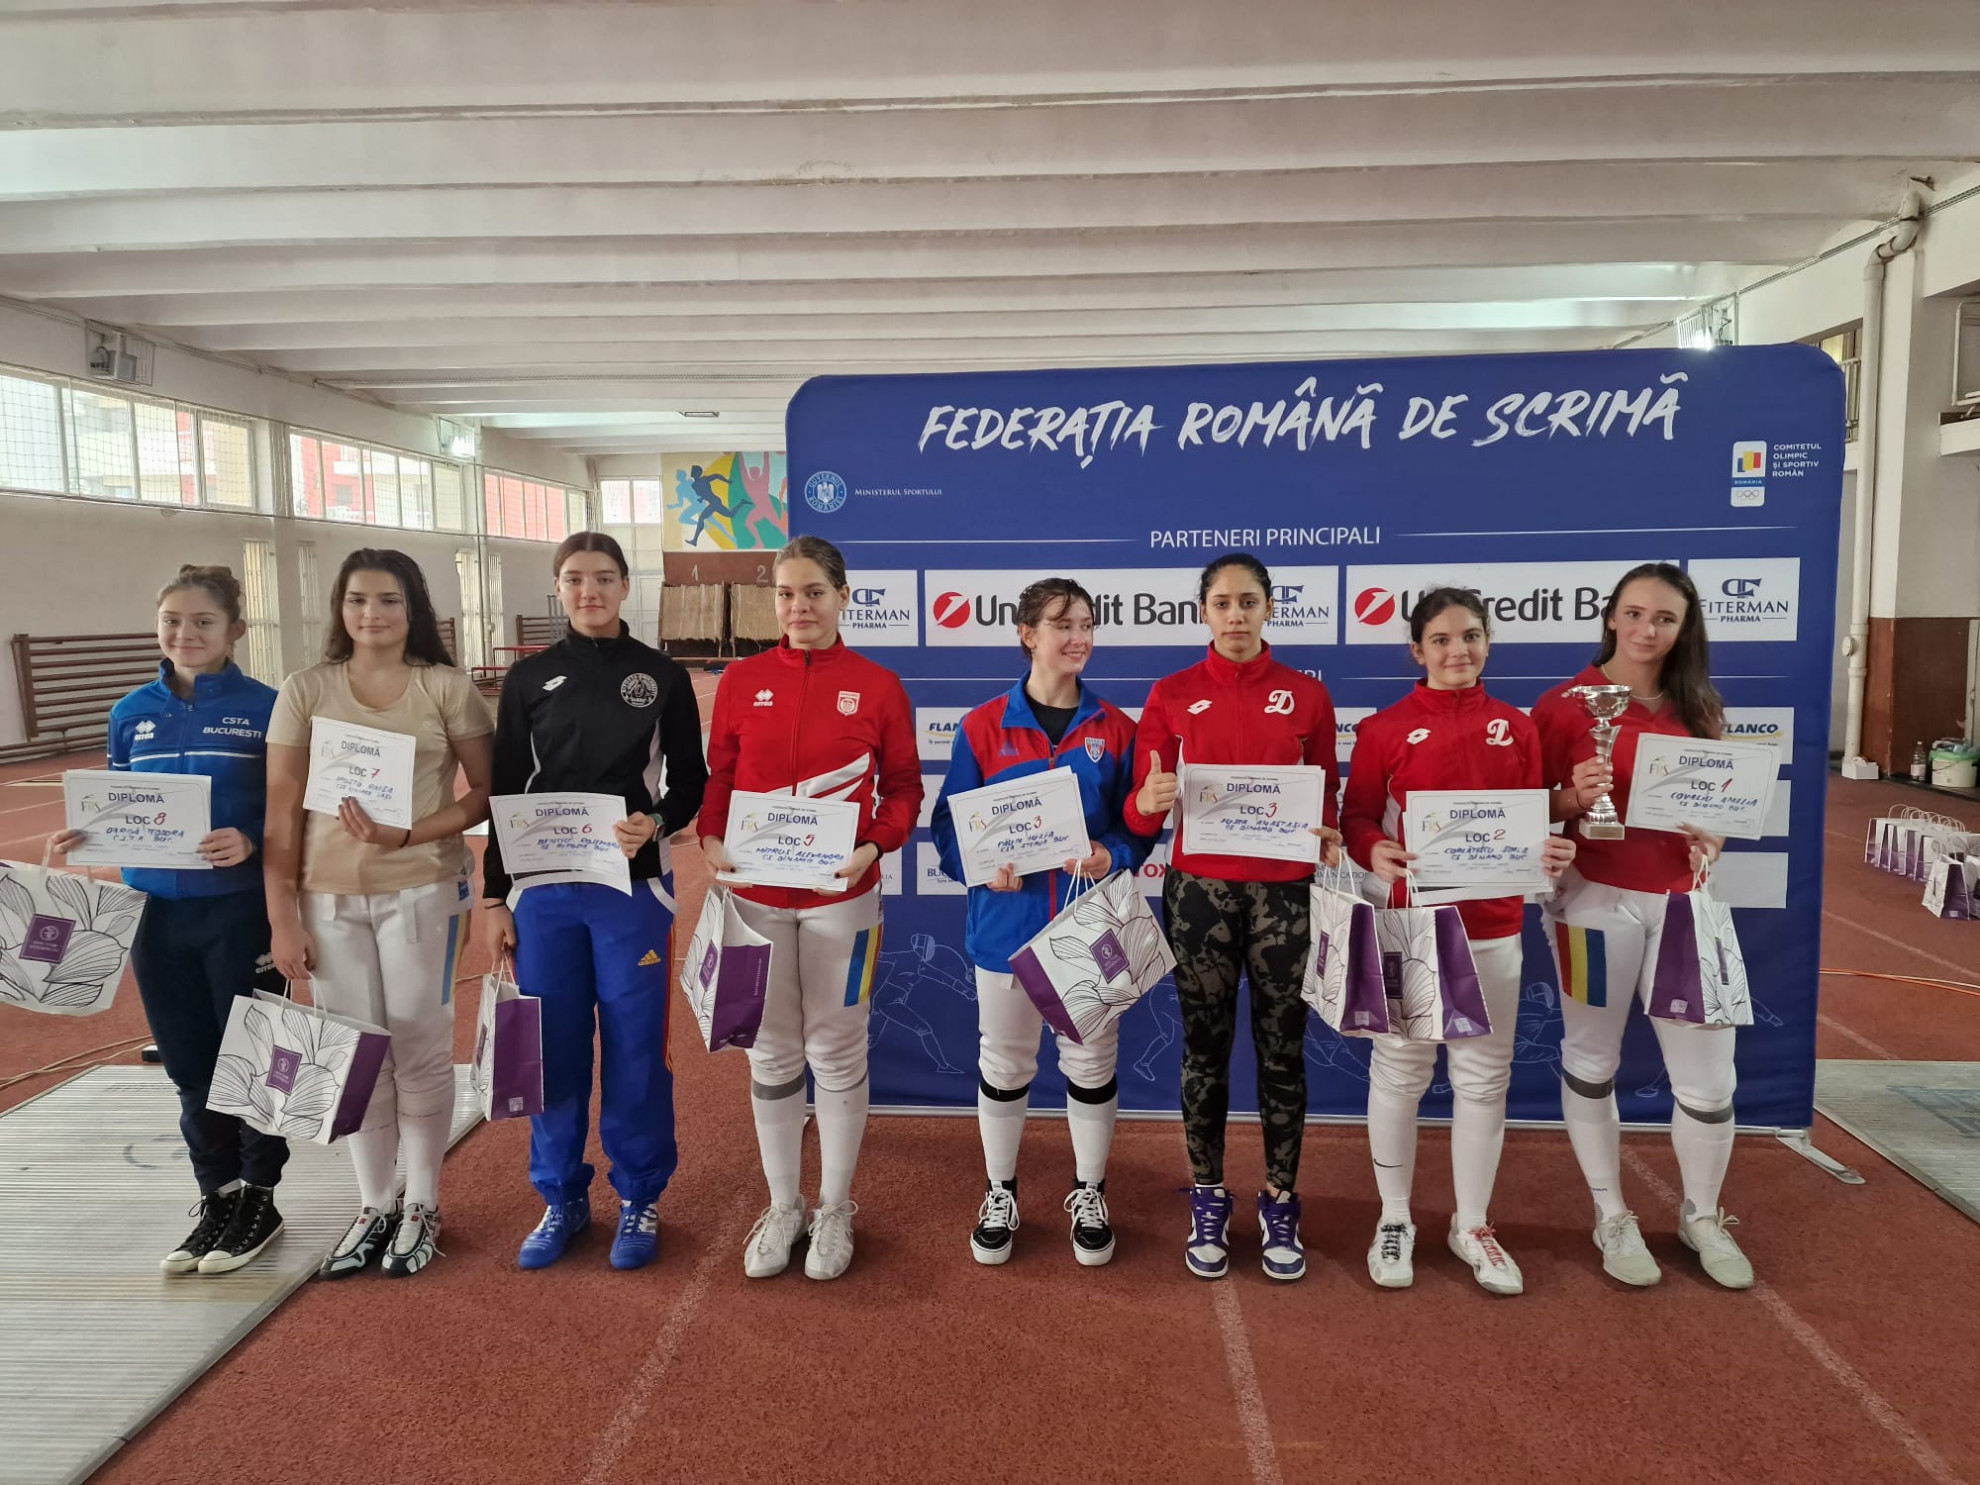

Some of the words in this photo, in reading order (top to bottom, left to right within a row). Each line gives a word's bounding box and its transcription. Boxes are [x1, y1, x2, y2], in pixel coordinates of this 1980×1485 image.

[1398, 393, 1469, 441] DE
[1773, 443, 1822, 451] COMITETUL
[1773, 452, 1808, 460] OLIMPIC
[1771, 470, 1804, 478] ROMÂN
[1149, 530, 1260, 548] PARTENERI
[1266, 527, 1381, 546] PRINCIPALI
[691, 564, 699, 581] 1
[756, 565, 768, 583] 2
[842, 609, 910, 621] ITERMAN
[1133, 593, 1200, 626] Ban
[1274, 606, 1329, 619] ERMAN
[222, 716, 250, 726] CSTA
[203, 726, 262, 738] BUCURESTI
[1727, 723, 1779, 733] LANCO
[349, 765, 367, 778] LOC
[371, 767, 380, 779] 7
[1690, 780, 1716, 791] LOC
[1721, 778, 1733, 793] 1
[1240, 805, 1264, 815] LOC
[125, 815, 151, 825] LOC
[154, 812, 167, 825] 8
[1009, 821, 1031, 835] LOC
[1034, 815, 1042, 829] 3
[553, 826, 578, 835] LOC
[581, 823, 593, 834] 6
[778, 836, 801, 846] LOC
[1465, 832, 1490, 843] LOC
[1493, 829, 1506, 840] 2
